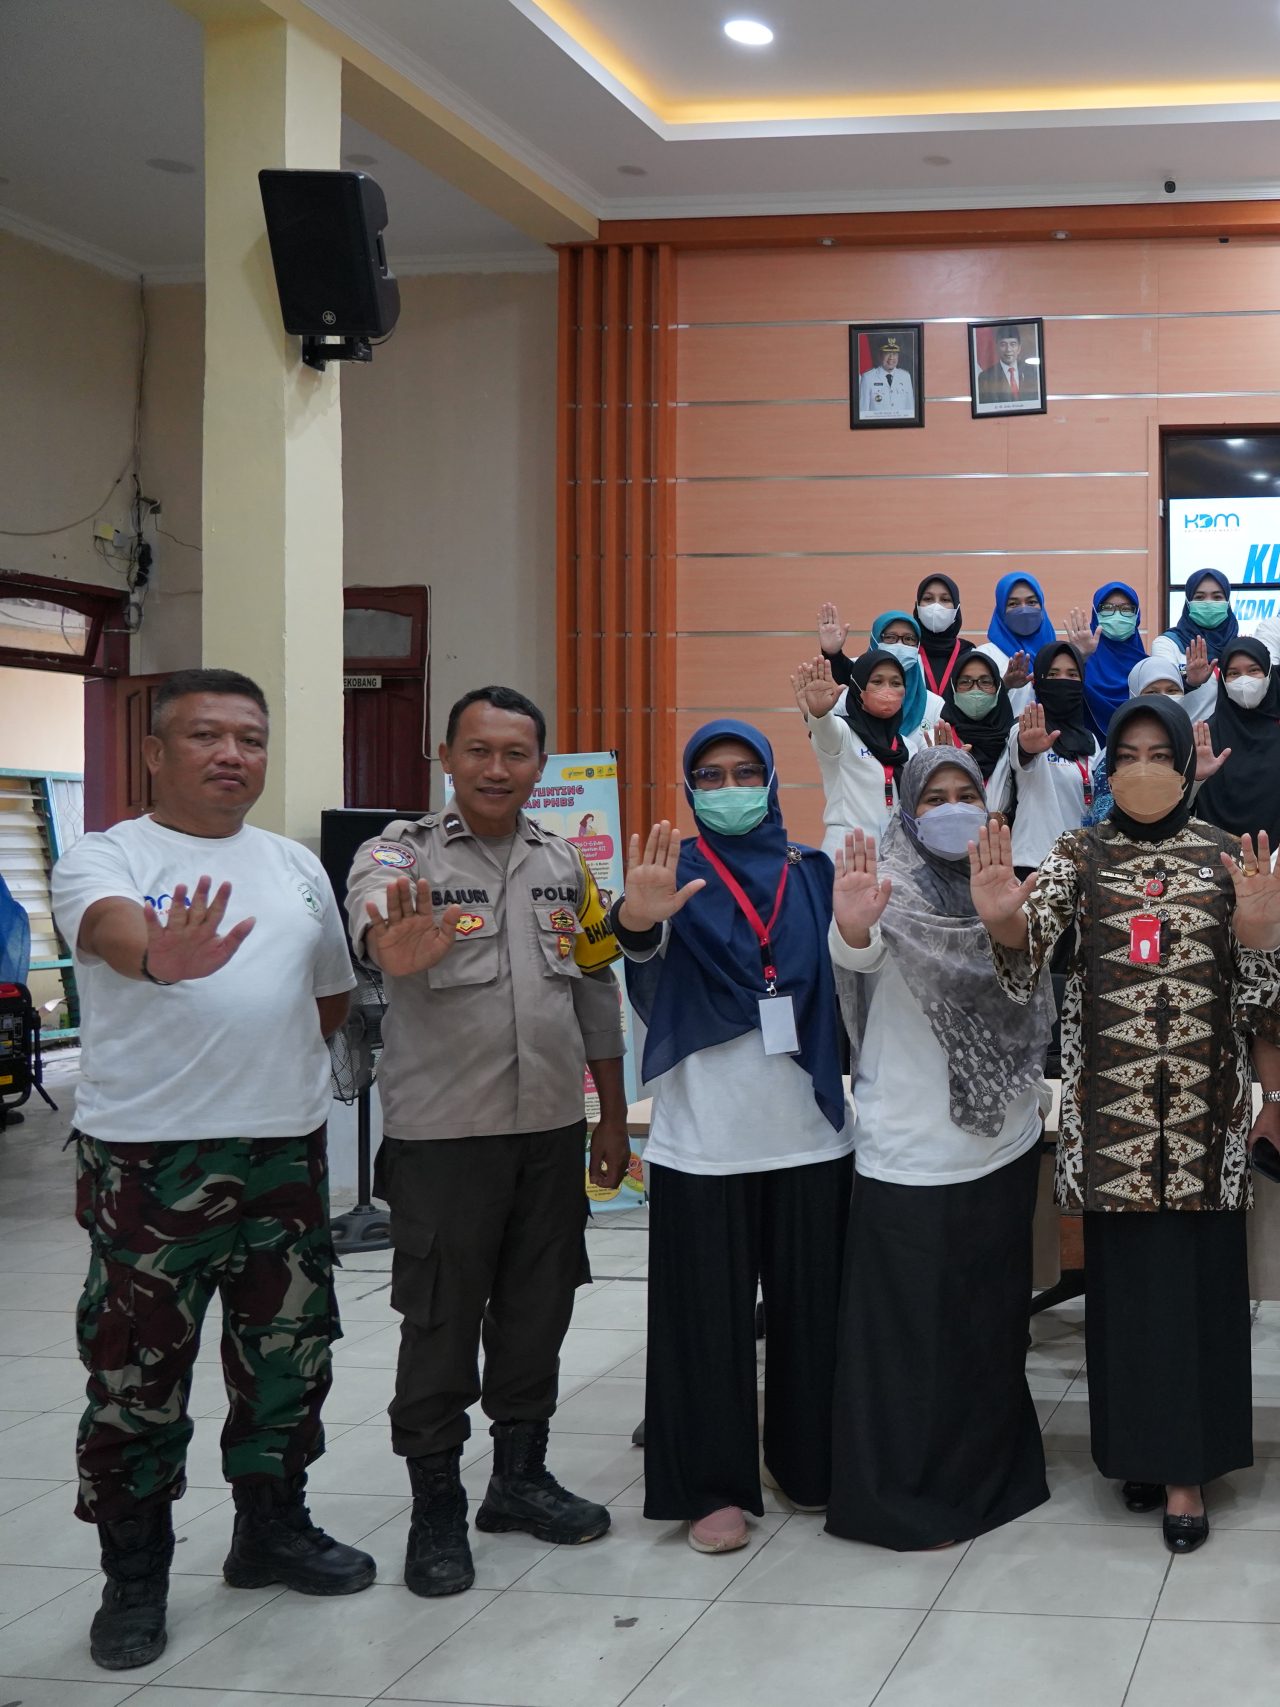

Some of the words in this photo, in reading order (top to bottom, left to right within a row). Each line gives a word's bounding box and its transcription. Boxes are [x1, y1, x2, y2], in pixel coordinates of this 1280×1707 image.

[1234, 599, 1275, 620] KDM
[532, 785, 584, 797] TUNTING
[544, 797, 574, 808] PHBS
[431, 889, 489, 906] BAJURI
[531, 886, 578, 904] POLRI
